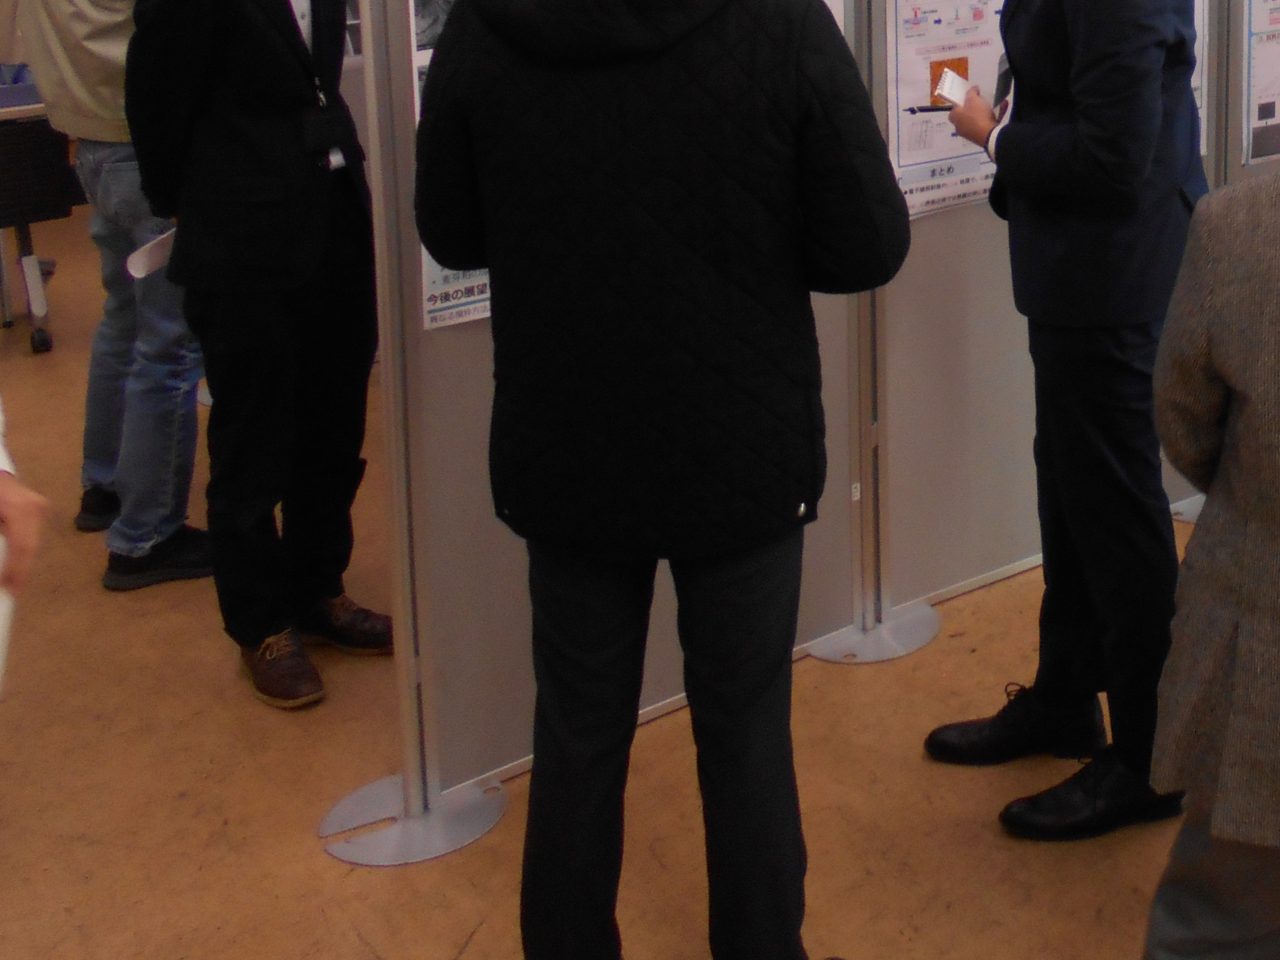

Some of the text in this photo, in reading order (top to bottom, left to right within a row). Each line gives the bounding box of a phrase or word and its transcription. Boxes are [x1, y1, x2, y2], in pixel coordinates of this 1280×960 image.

[930, 166, 955, 178] まとめ
[427, 283, 487, 306] 今後の展望
